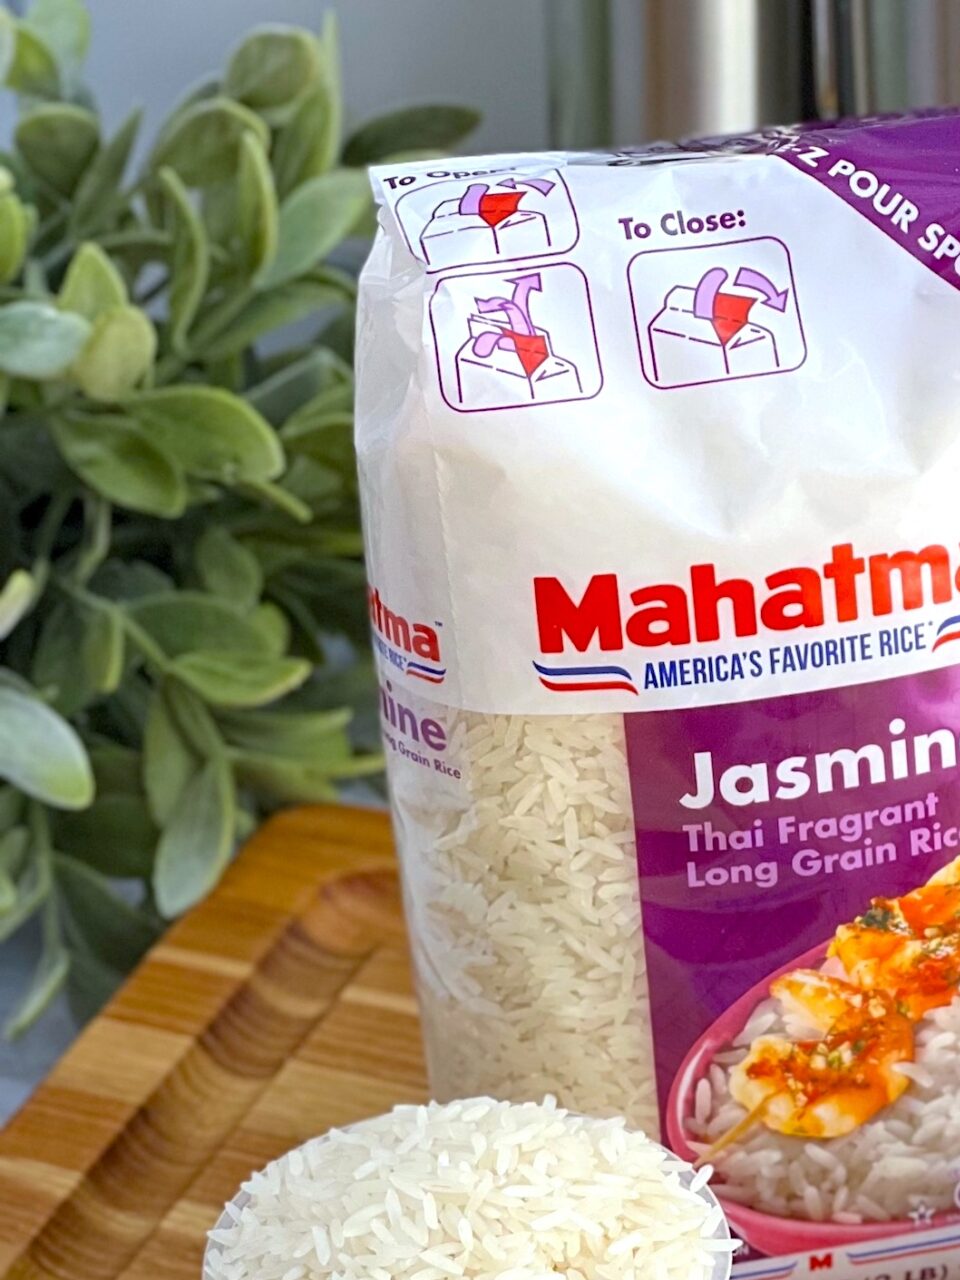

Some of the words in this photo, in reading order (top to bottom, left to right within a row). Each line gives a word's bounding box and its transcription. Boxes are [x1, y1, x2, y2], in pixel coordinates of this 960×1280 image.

[383, 176, 416, 190] To
[828, 159, 919, 233] POUR
[618, 217, 651, 240] To
[660, 210, 746, 236] Close:
[644, 650, 762, 689] AMERICA'S
[769, 633, 873, 675] FAVORITE
[879, 623, 927, 658] RICE
[434, 758, 462, 779] Rice
[682, 818, 764, 852] Thai
[778, 792, 939, 845] Fragrant
[686, 861, 778, 888] Long
[791, 838, 897, 877] Grain
[809, 1254, 832, 1271] M
